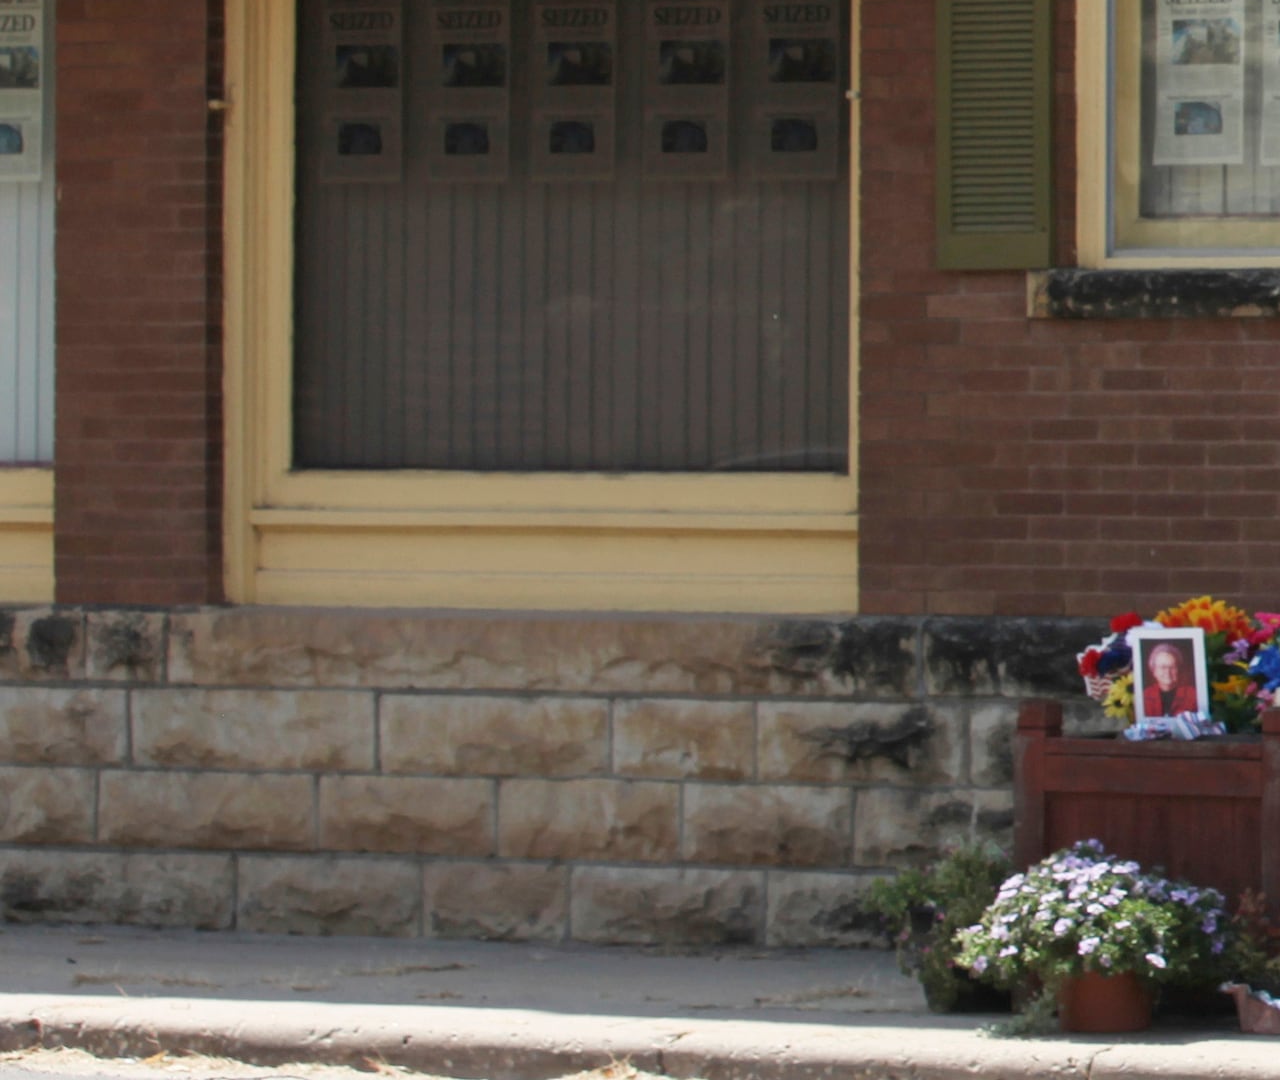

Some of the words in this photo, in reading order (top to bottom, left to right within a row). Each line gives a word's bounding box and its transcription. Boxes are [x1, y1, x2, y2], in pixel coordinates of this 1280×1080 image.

[329, 11, 394, 31] SEIZED
[437, 10, 502, 29] SEIZED
[542, 8, 609, 27] SEIZED
[653, 6, 721, 25] SEIZED
[763, 4, 832, 23] SEIZED
